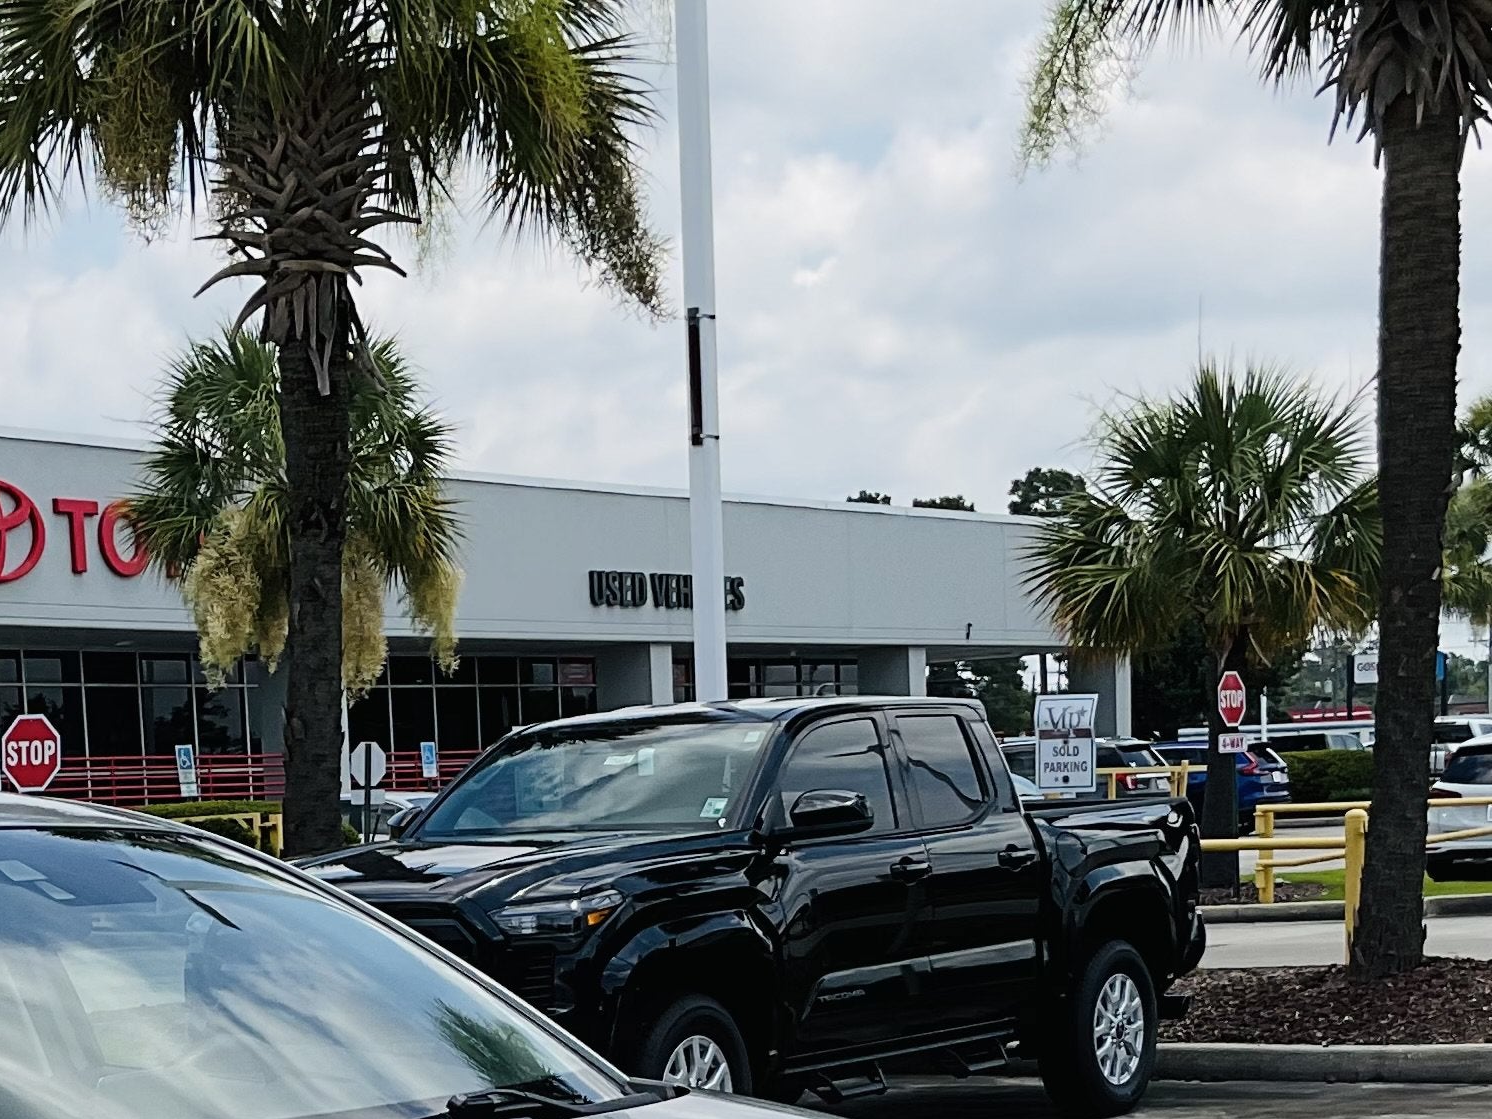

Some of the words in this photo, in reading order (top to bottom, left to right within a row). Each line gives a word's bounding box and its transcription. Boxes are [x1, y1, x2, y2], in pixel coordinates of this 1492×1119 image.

[588, 570, 648, 608] USED
[649, 572, 746, 611] VEHES
[1220, 689, 1243, 708] STOP
[1052, 745, 1080, 757] SOLD
[1221, 736, 1244, 750] 4-WAY
[7, 740, 56, 767] STOP
[1043, 760, 1088, 773] PARKING
